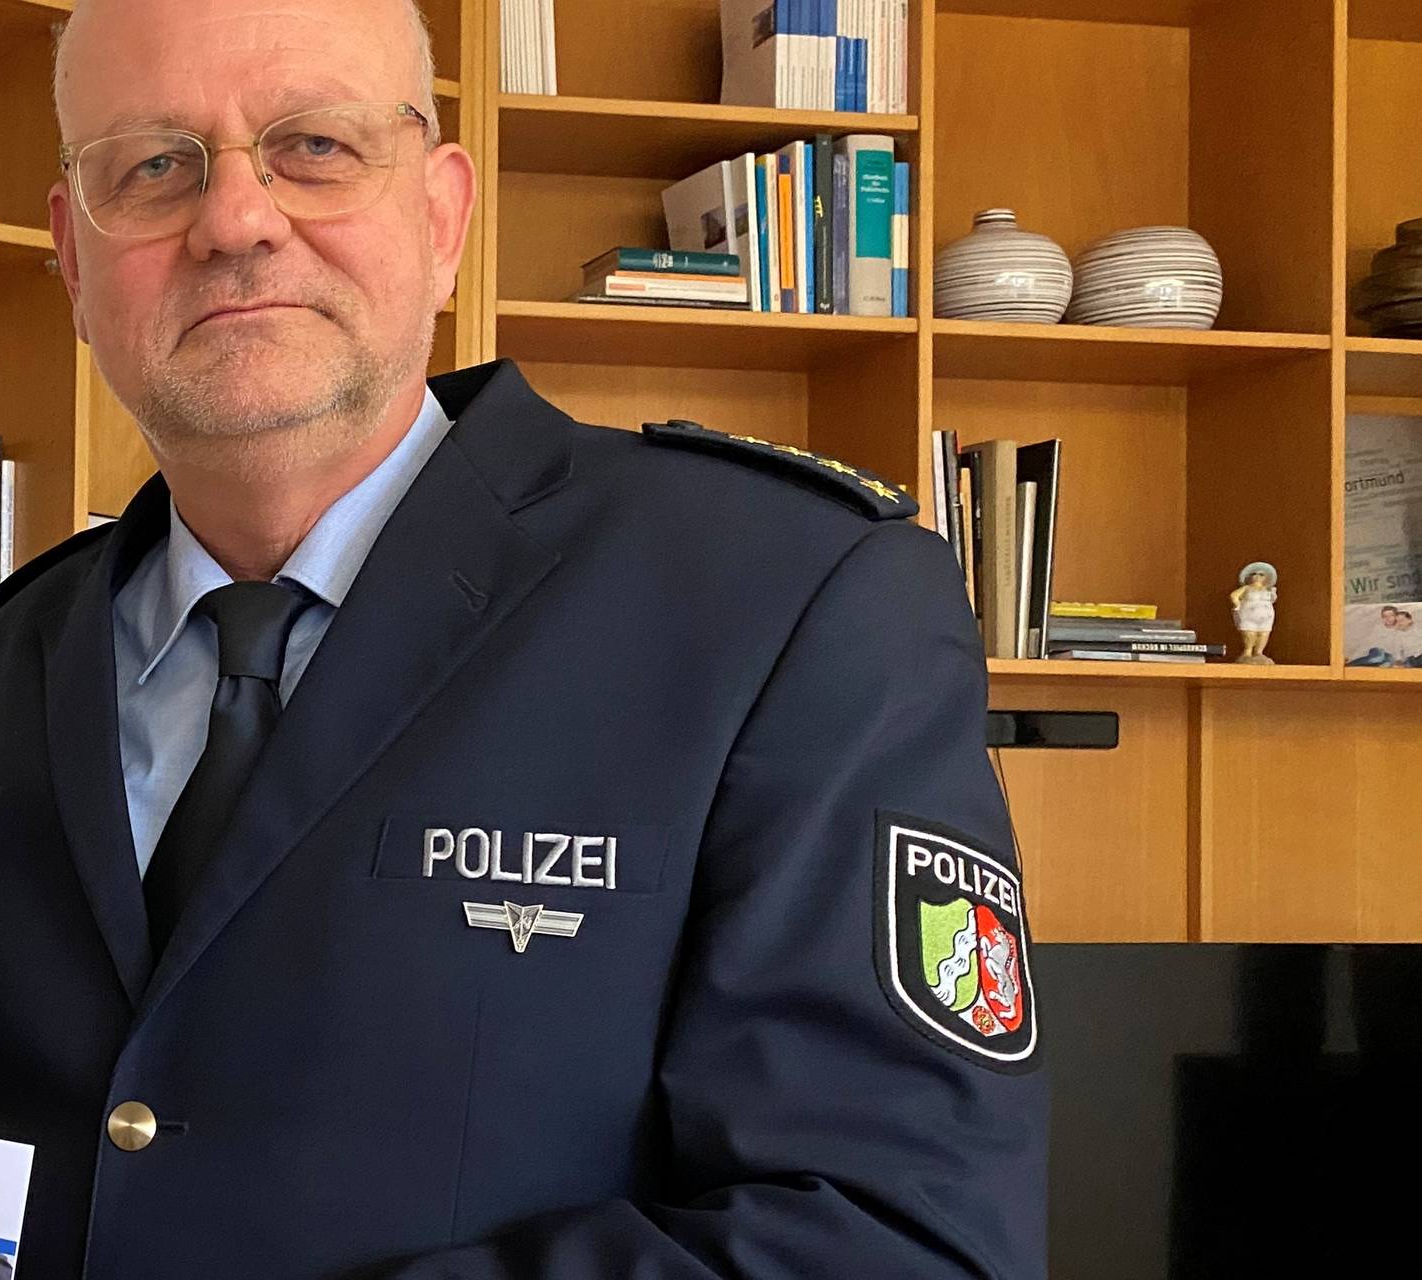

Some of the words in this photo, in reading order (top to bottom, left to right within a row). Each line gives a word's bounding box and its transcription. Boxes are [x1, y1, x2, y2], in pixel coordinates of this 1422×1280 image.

[1345, 470, 1405, 492] ortmund
[1350, 577, 1379, 594] Wir
[422, 827, 617, 890] POLIZEI
[907, 844, 1018, 917] POLIZEI
